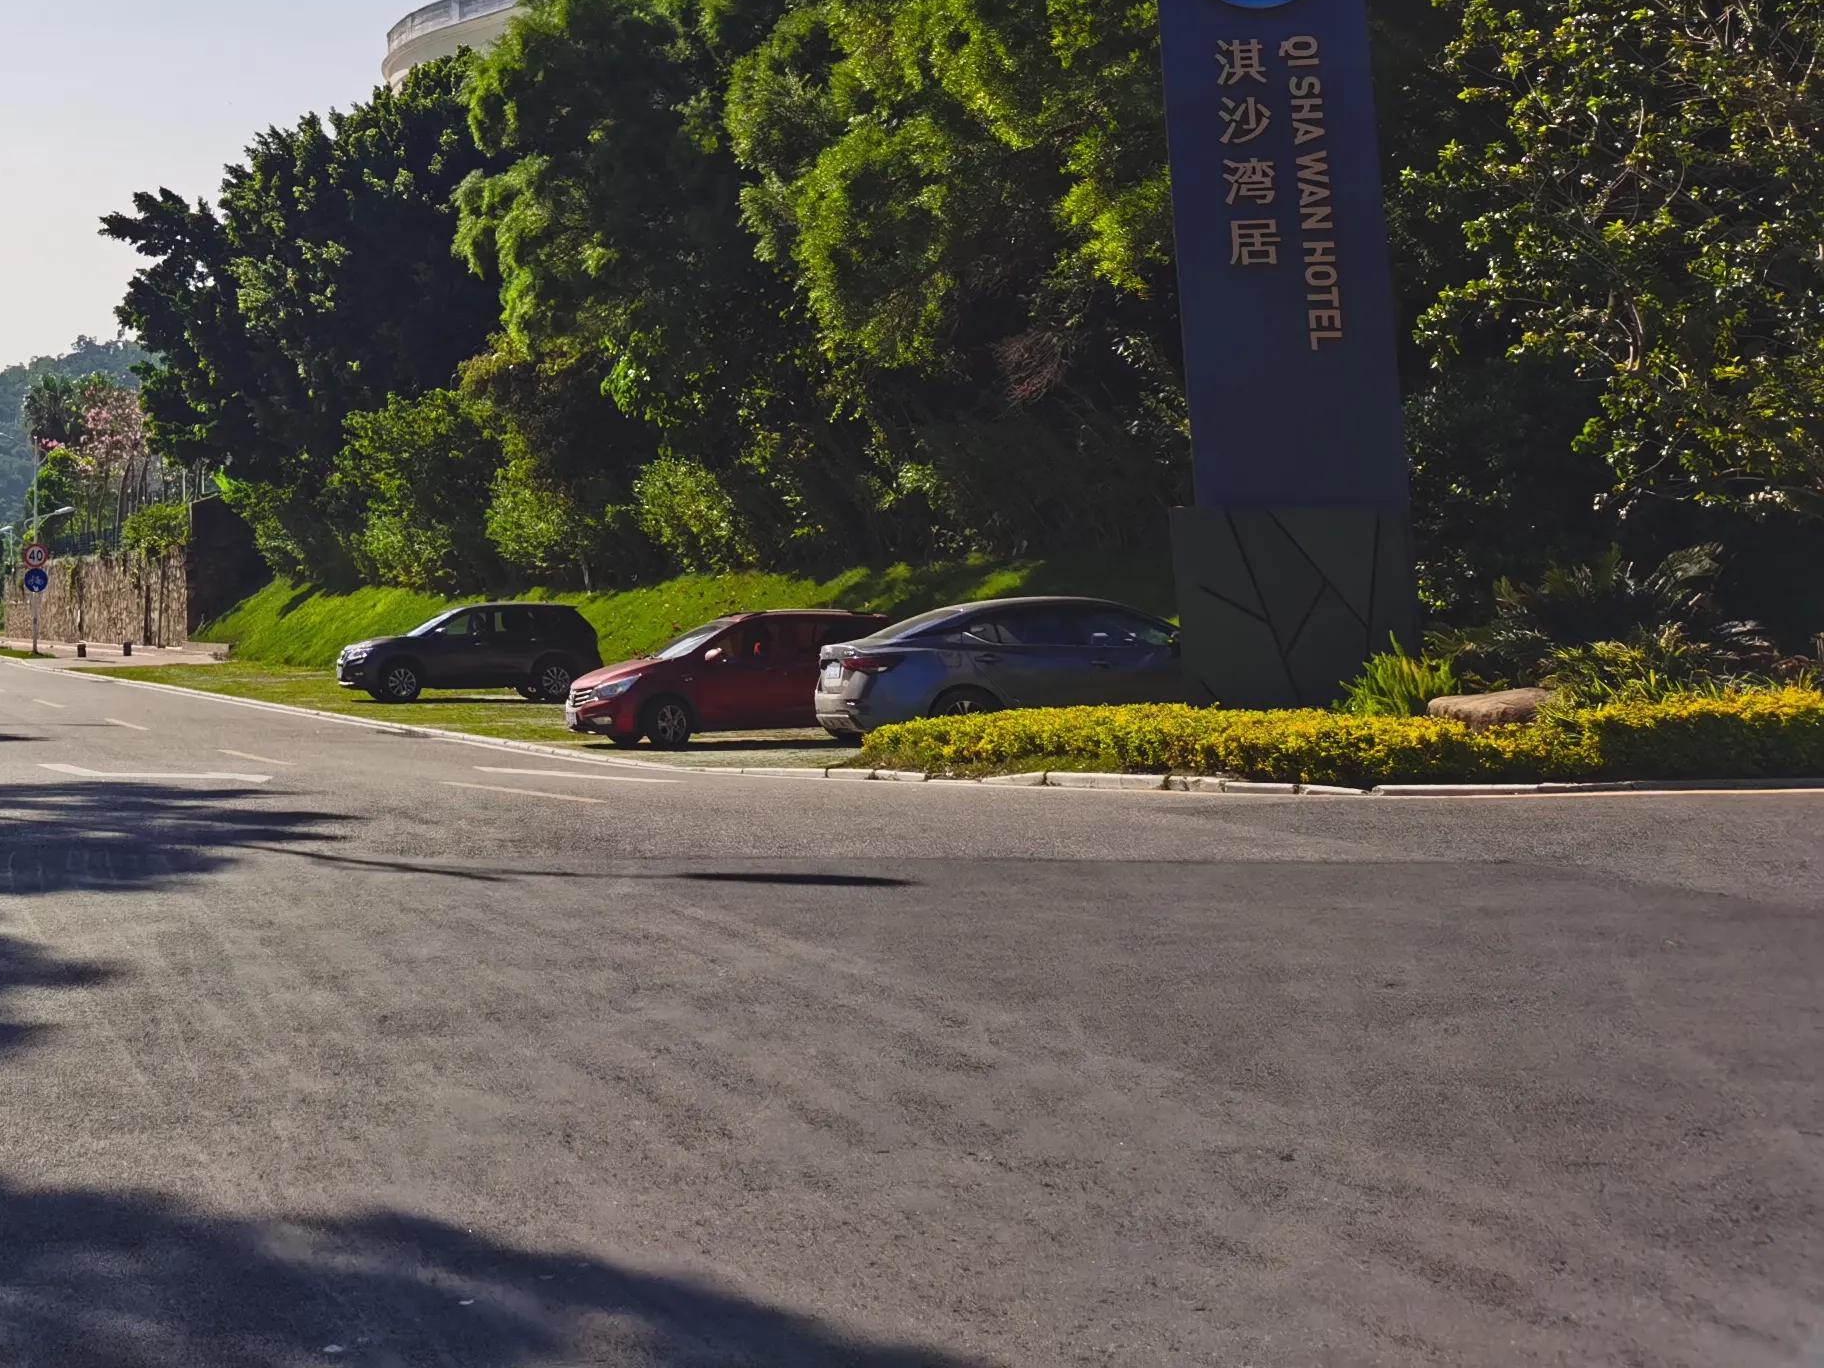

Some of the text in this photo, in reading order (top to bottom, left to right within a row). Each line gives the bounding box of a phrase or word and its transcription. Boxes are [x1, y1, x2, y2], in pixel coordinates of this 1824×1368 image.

[1215, 38, 1281, 265] 淇沙湾居
[1278, 35, 1343, 350] QI SHA WAN HOTEL
[28, 548, 43, 561] 40
